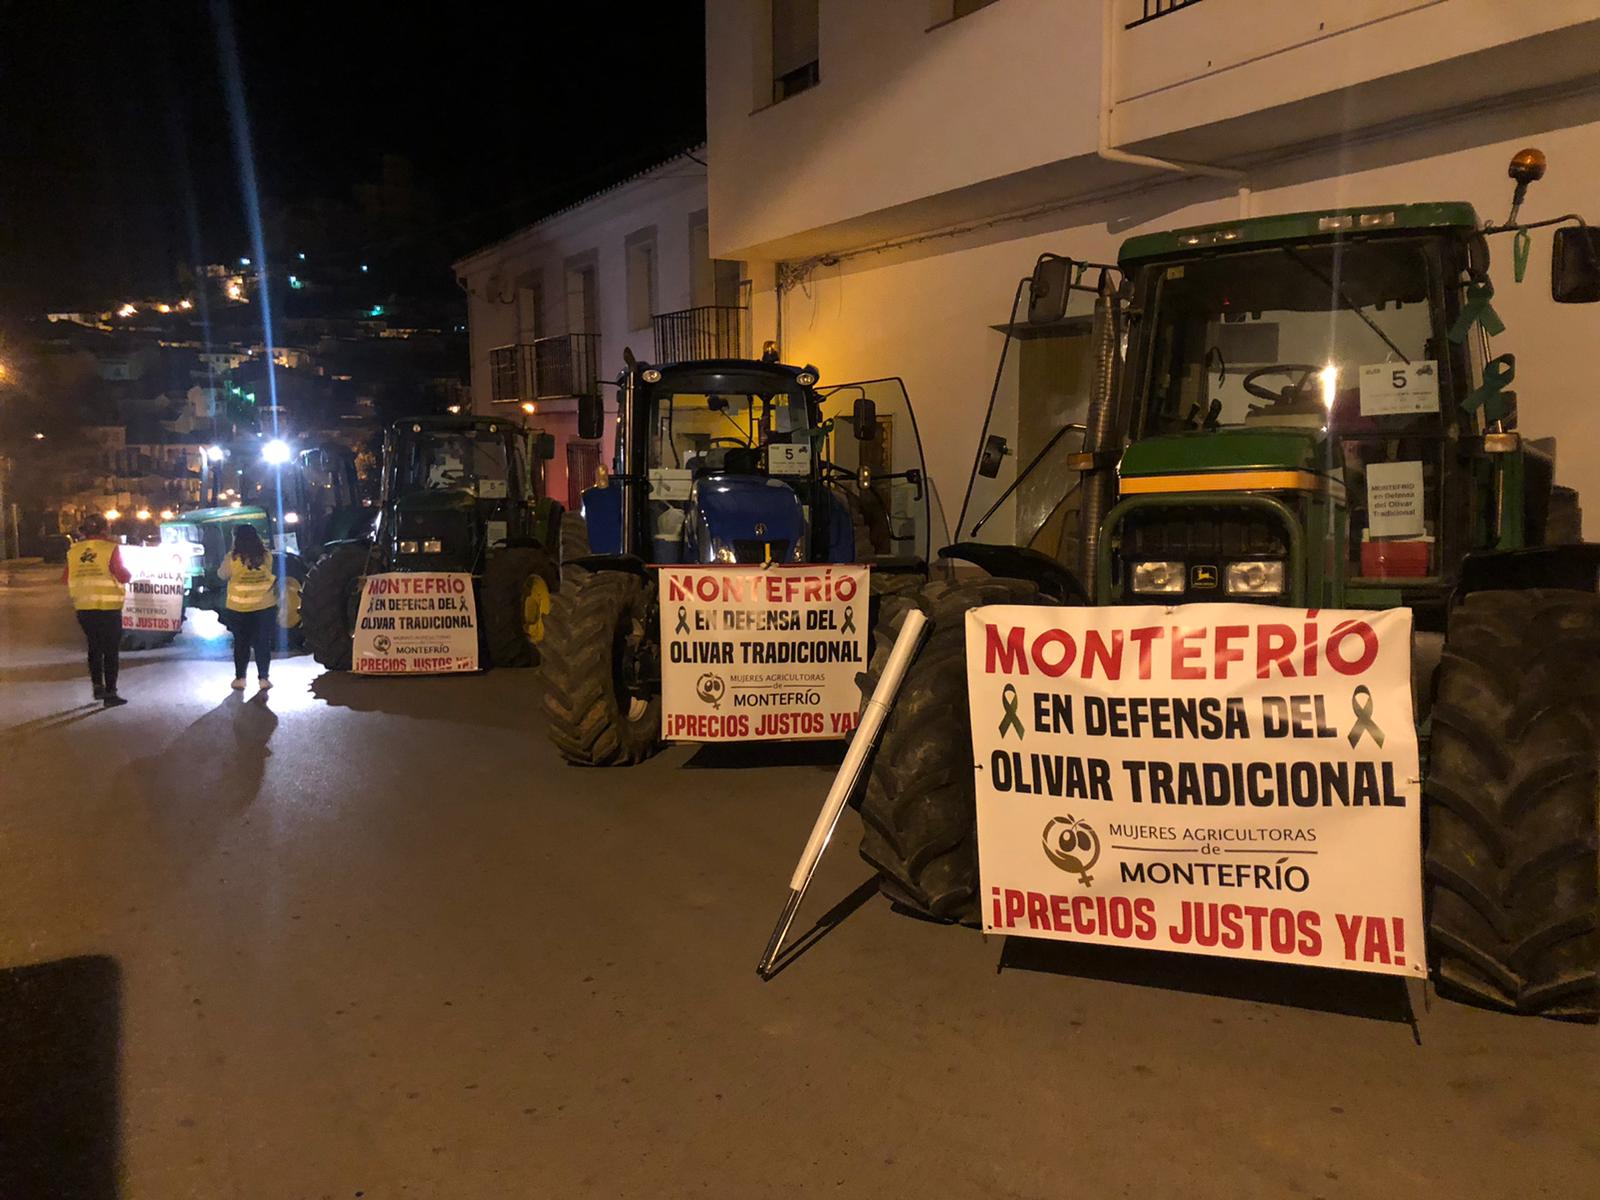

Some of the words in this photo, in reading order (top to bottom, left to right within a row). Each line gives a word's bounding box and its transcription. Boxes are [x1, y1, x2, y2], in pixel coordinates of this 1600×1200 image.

[1392, 370, 1407, 389] 5
[785, 448, 794, 460] 5
[368, 575, 466, 595] MONTEFRÍO
[668, 569, 858, 603] MONTEFRÍO
[375, 599, 386, 611] EN
[388, 598, 435, 611] DEFENSA
[438, 597, 457, 610] DEL
[136, 616, 169, 629] JUSTOS
[360, 617, 396, 630] OLIVAR
[398, 615, 474, 630] TRADICIONAL
[695, 610, 717, 631] EN
[723, 609, 801, 631] DEFENSA
[806, 609, 837, 631] DEL
[396, 643, 450, 655] MONTEFRÍO
[670, 641, 735, 664] OLIVAR
[740, 640, 863, 664] TRADICIONAL
[984, 608, 1380, 681] MONTEFRÍO
[356, 657, 407, 672] ¡PRECIOS
[730, 673, 764, 682] MUJERES
[765, 673, 826, 682] AGRICULTORAS
[772, 682, 783, 690] de
[733, 689, 821, 707] MONTEFRÍO
[667, 713, 750, 737] ¡PRECIOS
[754, 712, 825, 736] JUSTOS
[1033, 692, 1075, 735] EN
[1084, 695, 1251, 739] DEFENSA
[1261, 694, 1338, 739] DEL
[990, 750, 1114, 802] OLIVAR
[1122, 760, 1406, 808] TRADICIONAL
[1109, 823, 1177, 842] MUJERES
[1182, 827, 1318, 843] AGRICULTORAS
[1200, 843, 1221, 857] de
[1119, 856, 1310, 893] MONTEFRÍO
[992, 887, 1158, 942] ¡PRECIOS
[1168, 901, 1323, 957] JUSTOS
[1334, 913, 1407, 967] YA!
